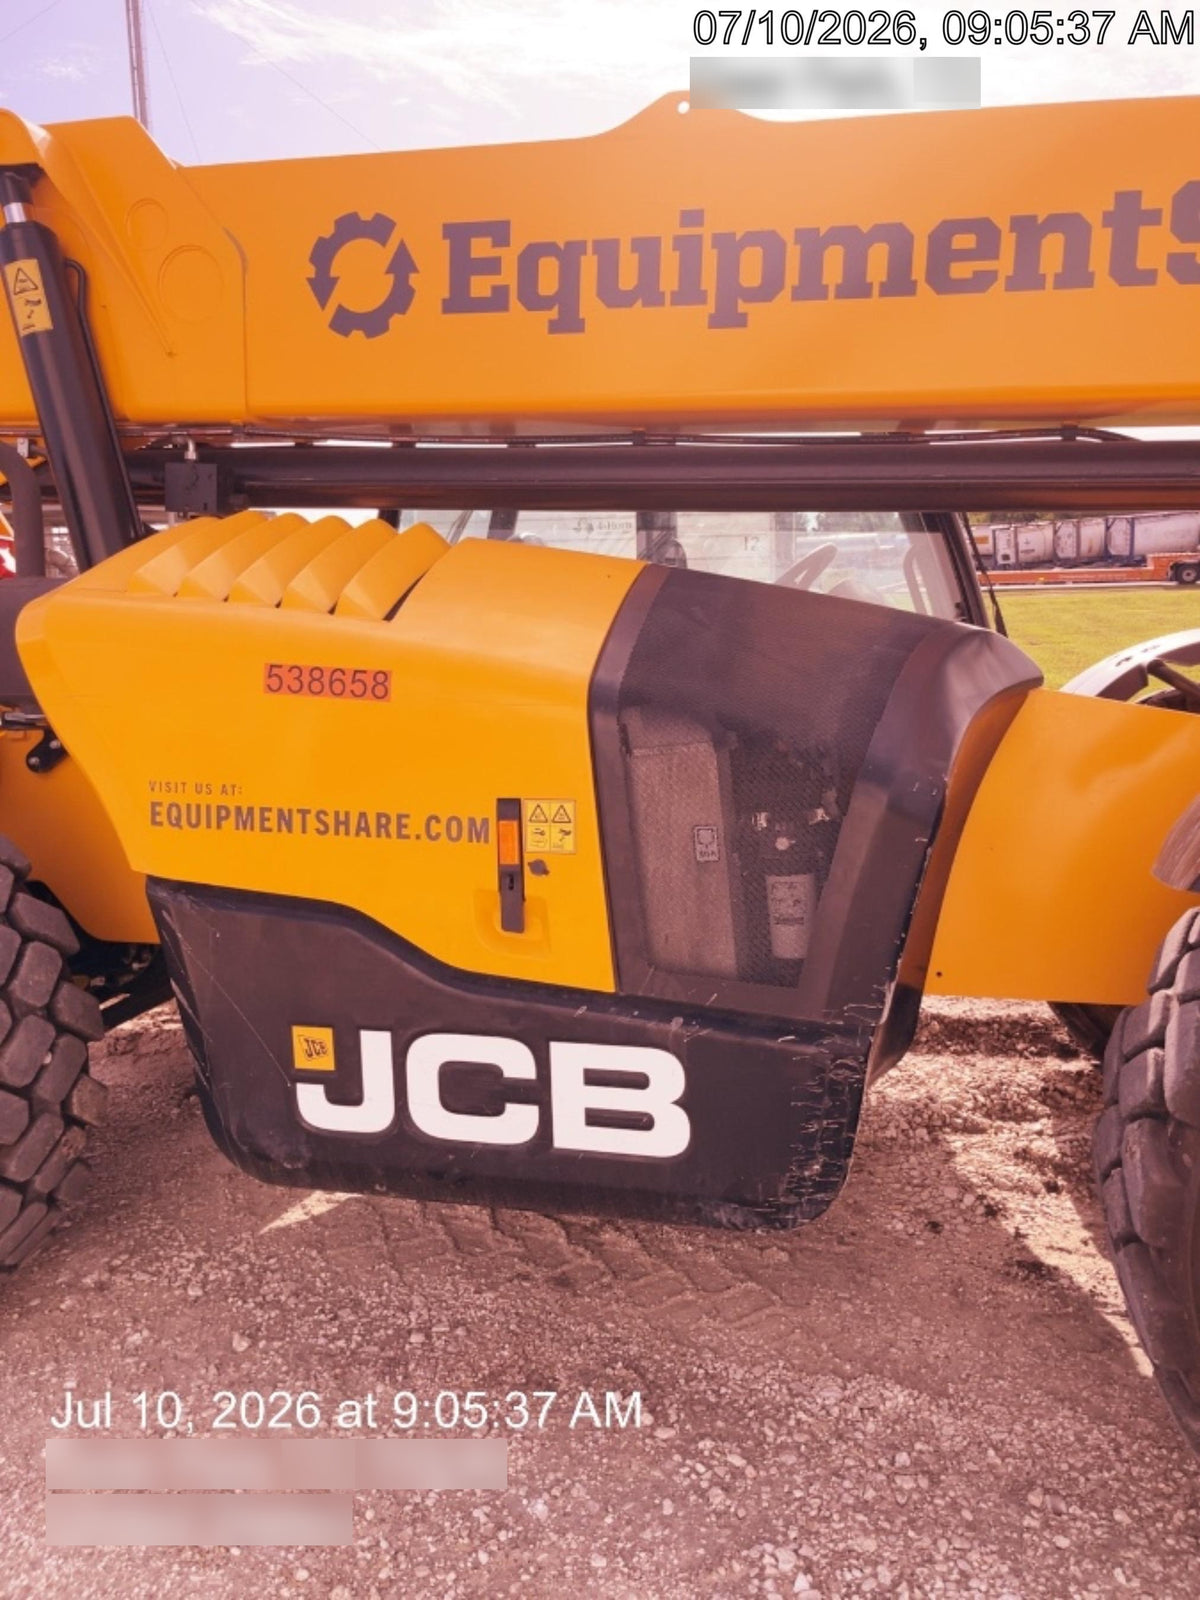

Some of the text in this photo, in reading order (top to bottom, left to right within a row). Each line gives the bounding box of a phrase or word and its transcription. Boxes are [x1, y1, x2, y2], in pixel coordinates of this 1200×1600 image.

[266, 664, 390, 700] 538658
[149, 780, 243, 797] VISIT US AT:
[150, 801, 491, 845] EQUIPMENTSHARE.COM
[304, 1037, 328, 1059] JCB
[296, 1029, 692, 1159] JCB
